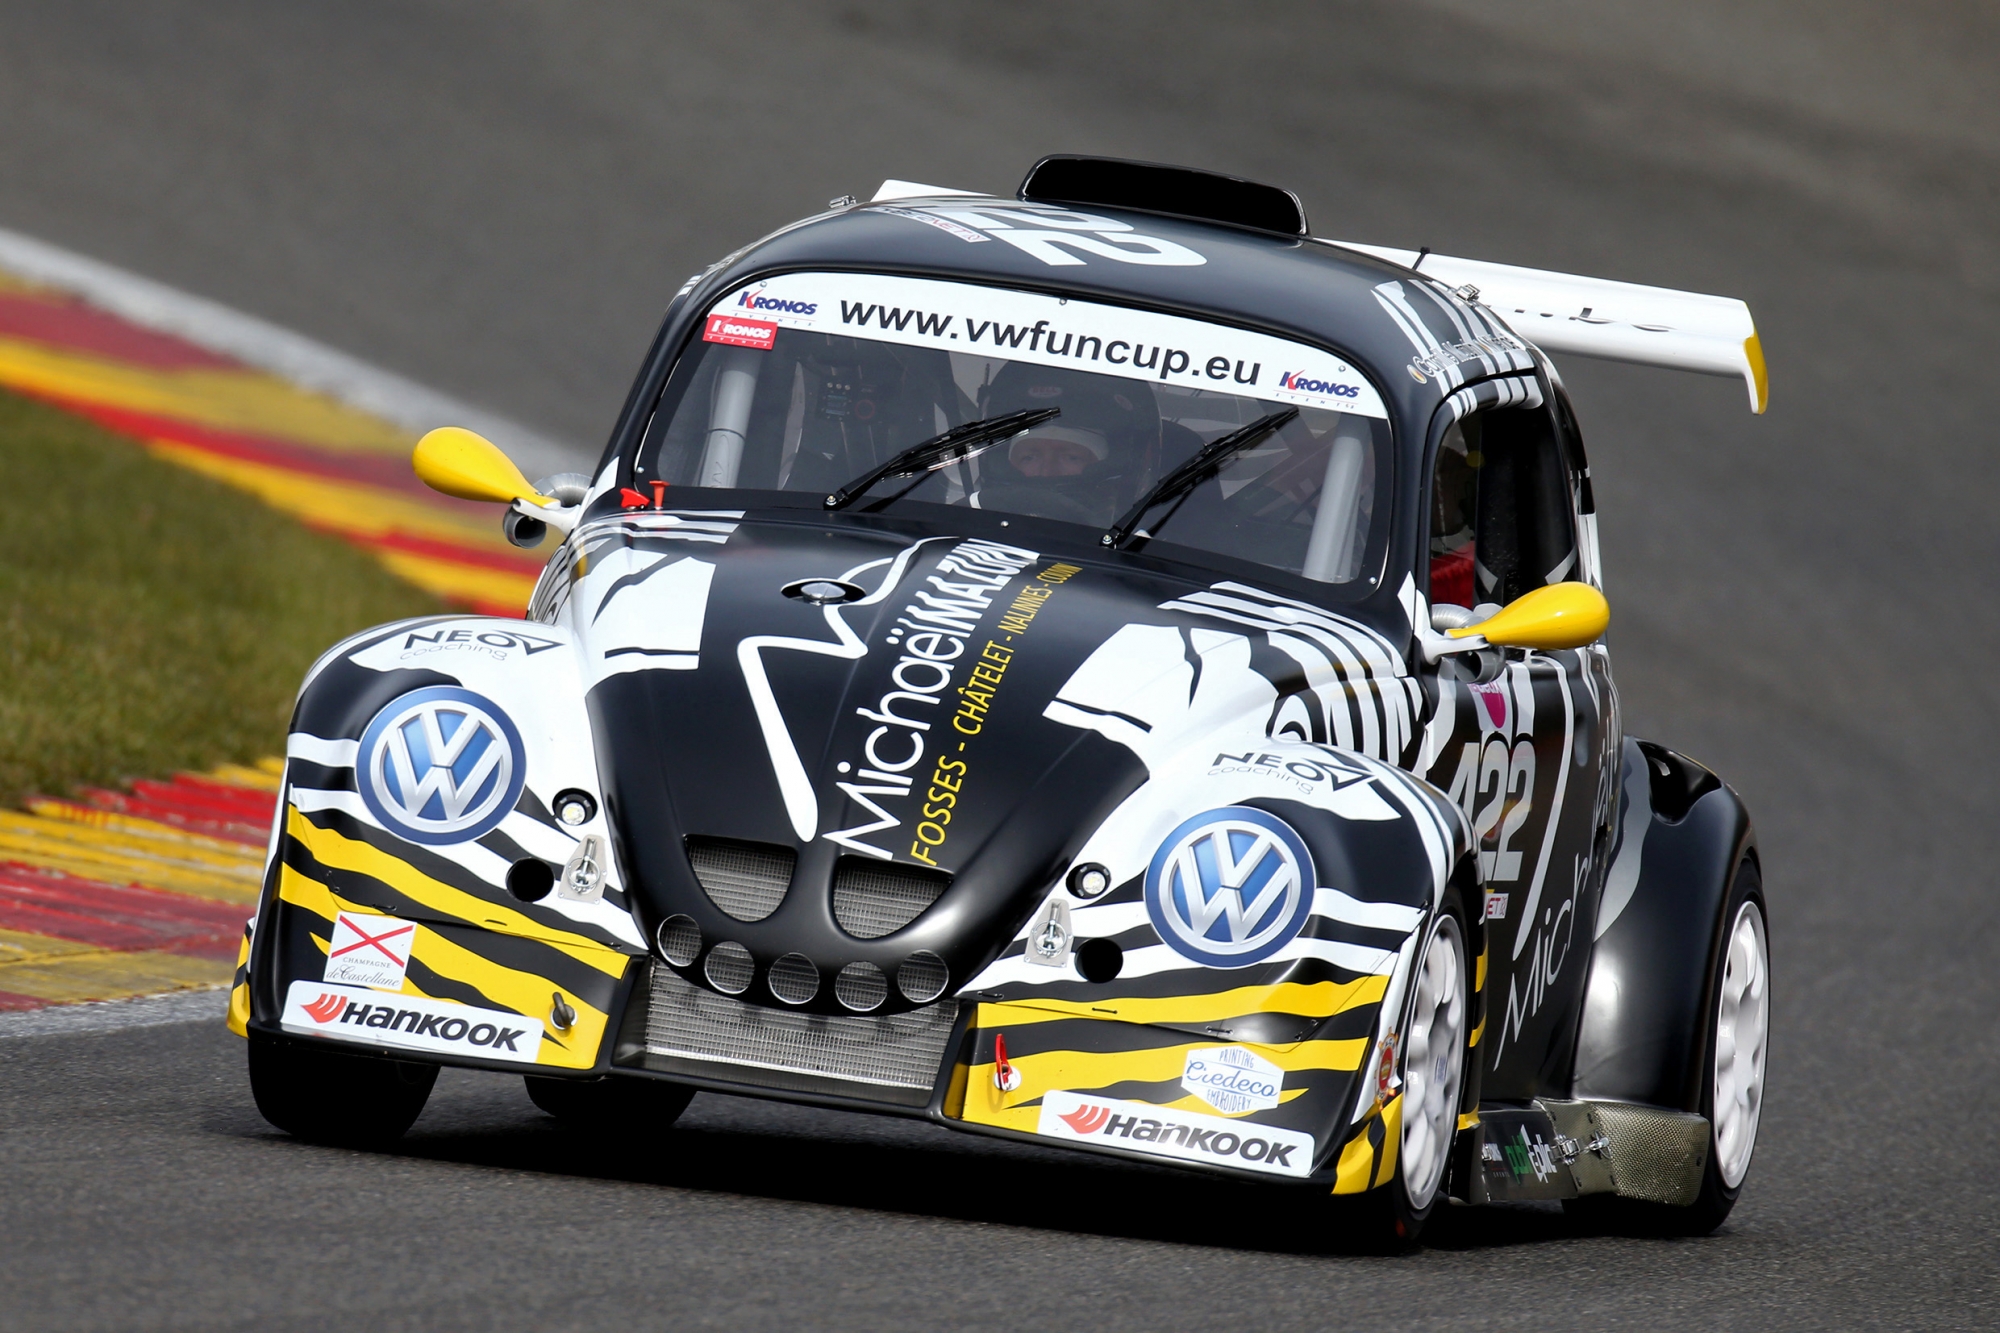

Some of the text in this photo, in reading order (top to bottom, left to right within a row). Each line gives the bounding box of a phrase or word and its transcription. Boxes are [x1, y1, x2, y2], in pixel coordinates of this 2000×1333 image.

[738, 289, 818, 315] KRONOS
[711, 318, 772, 338] KRONOS
[839, 298, 1260, 385] www.vwfuncup.eu
[1279, 369, 1360, 398] KRONOS
[400, 643, 507, 661] coaching
[911, 755, 967, 866] FOSSES
[953, 640, 1014, 735] CHÂTELET
[998, 585, 1053, 634] NALINNES
[1207, 766, 1314, 795] coaching
[343, 957, 392, 968] CHAMPAGNE
[340, 964, 400, 987] Castellane
[1219, 1048, 1254, 1068] PRINTING
[1206, 1089, 1252, 1112] EMBROIDERY
